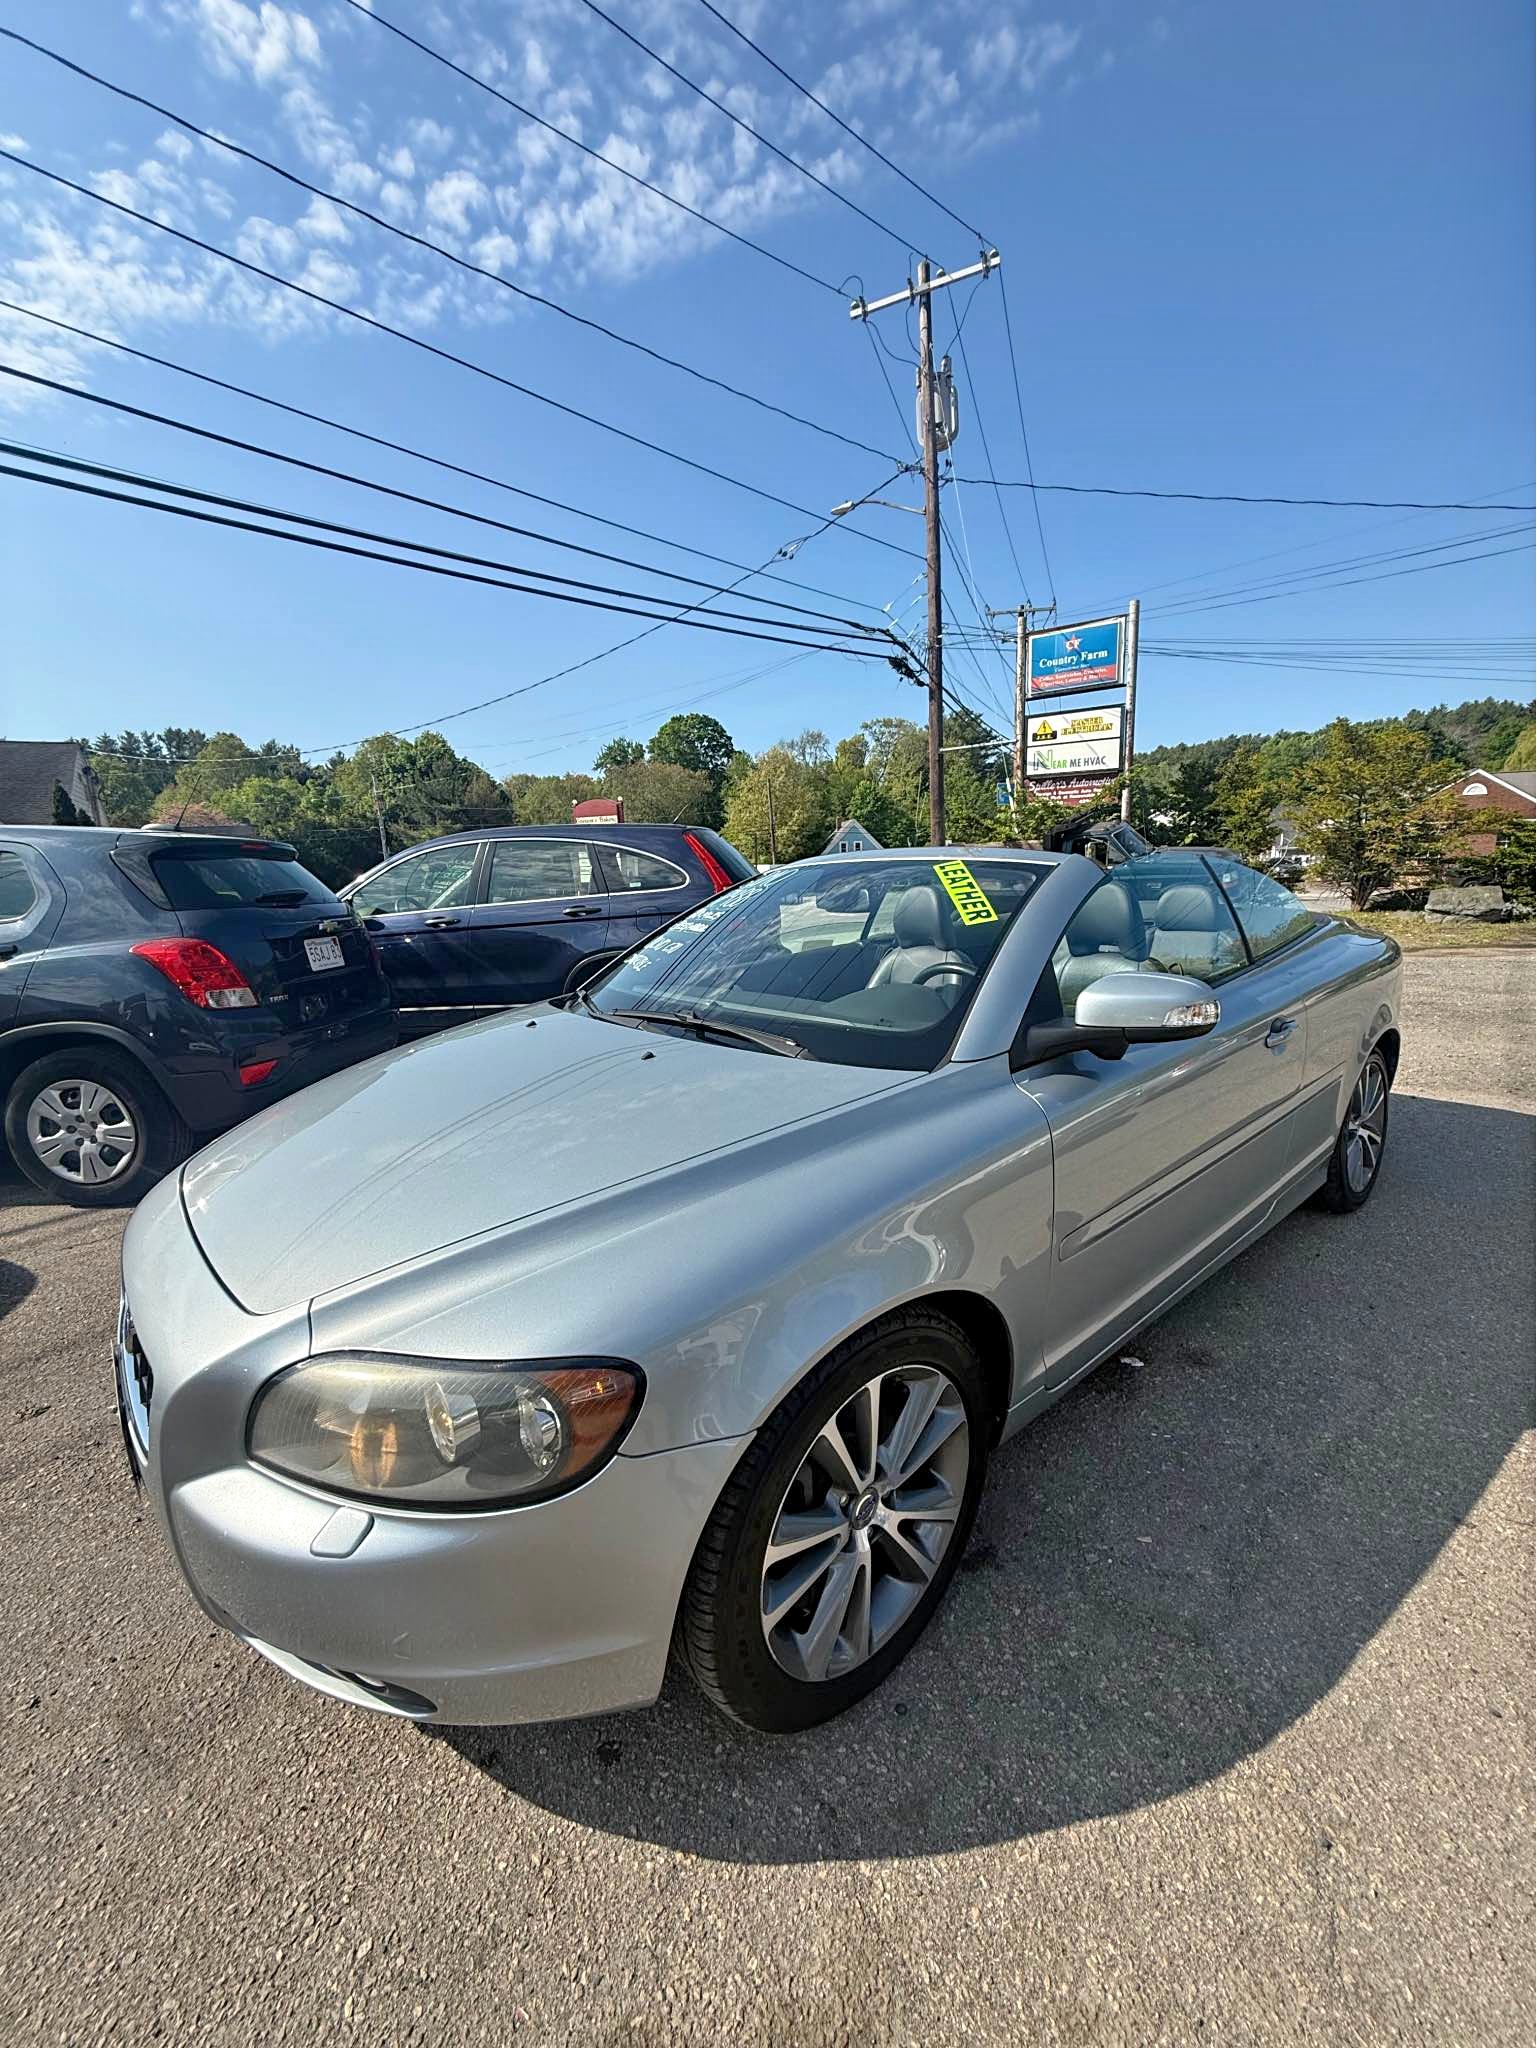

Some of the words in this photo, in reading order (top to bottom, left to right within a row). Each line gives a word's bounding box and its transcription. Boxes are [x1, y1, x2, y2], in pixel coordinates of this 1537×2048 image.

[1039, 655, 1078, 668] Country
[1081, 649, 1108, 661] Farm
[1033, 749, 1068, 771] NEAR
[1069, 759, 1082, 768] ME
[1083, 756, 1107, 768] HVAC
[1068, 776, 1116, 788] Automotiv
[939, 863, 992, 921] LEATHER
